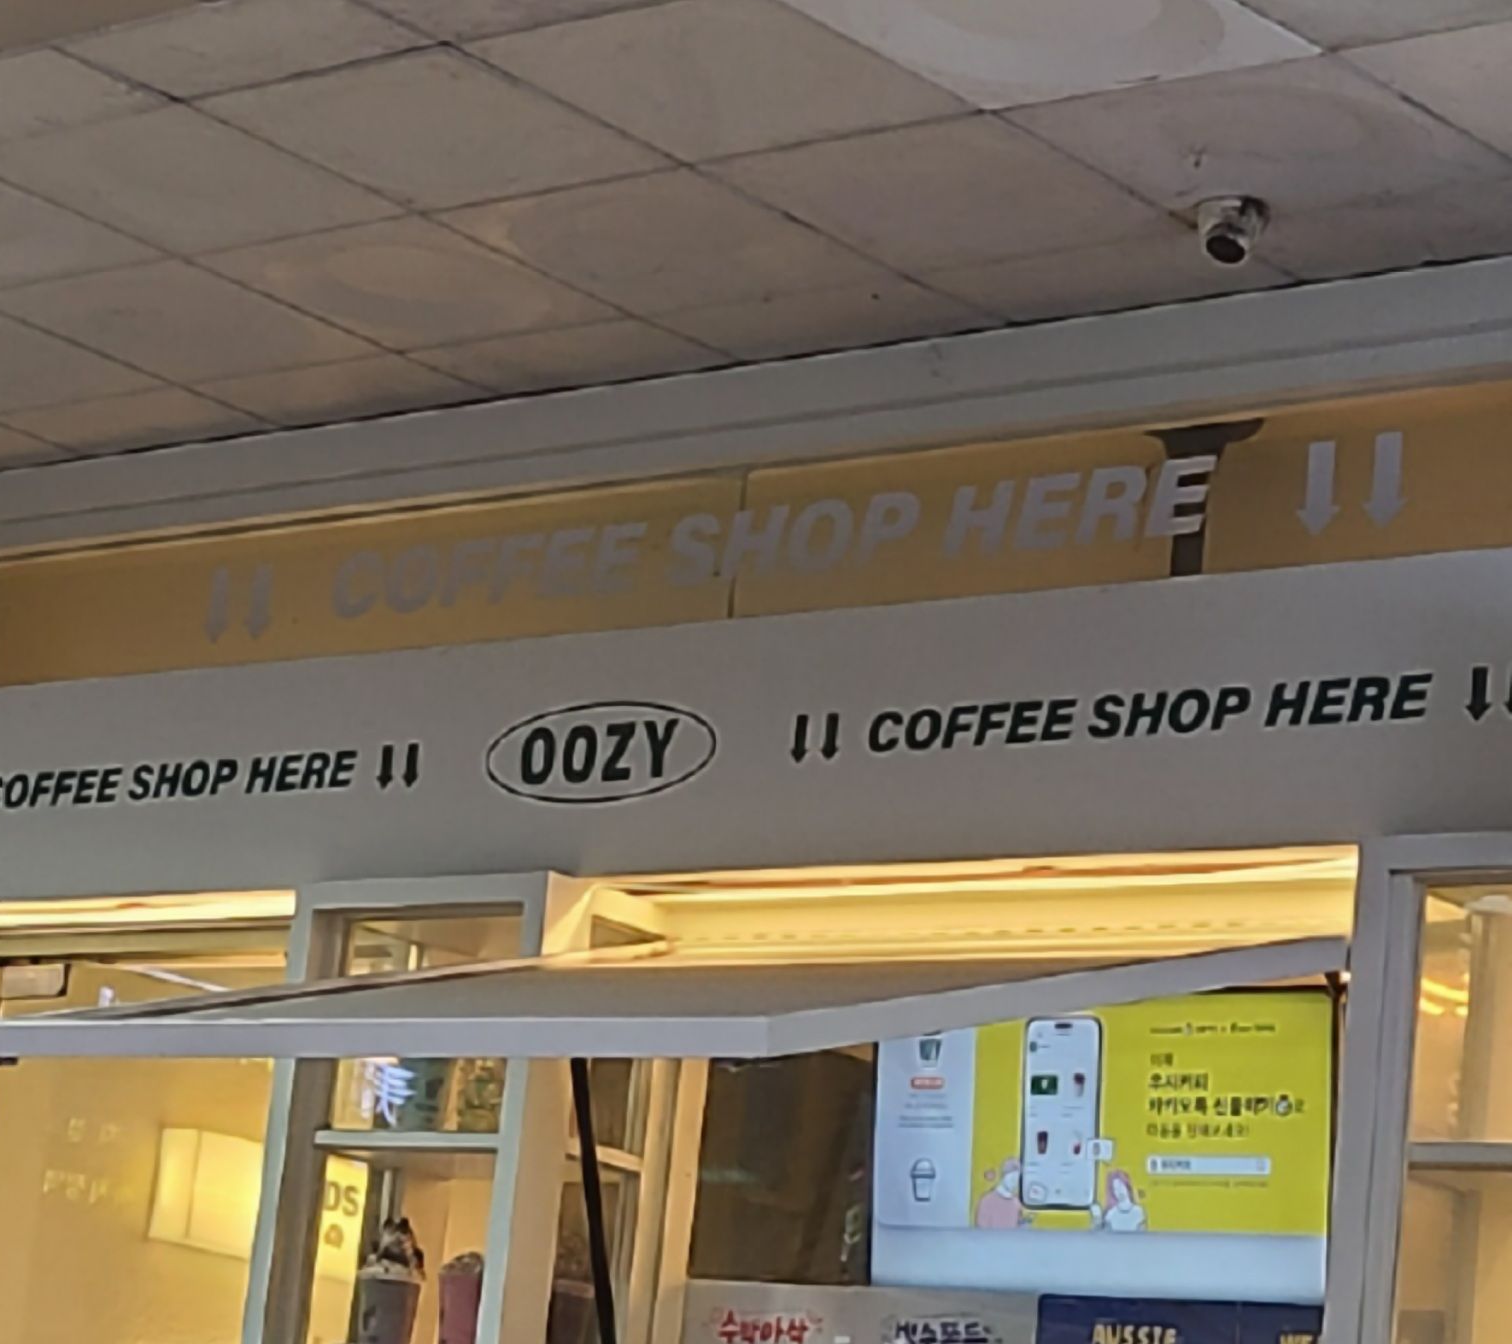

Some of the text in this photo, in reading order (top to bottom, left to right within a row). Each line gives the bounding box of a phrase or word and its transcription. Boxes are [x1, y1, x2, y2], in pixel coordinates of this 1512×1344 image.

[330, 455, 1218, 620] COFFEE SHOP HERE
[868, 672, 1434, 753] COFFEE SHOP HERE
[128, 758, 239, 799] SHOP
[245, 749, 358, 794] HERE
[519, 719, 680, 786] OOZY
